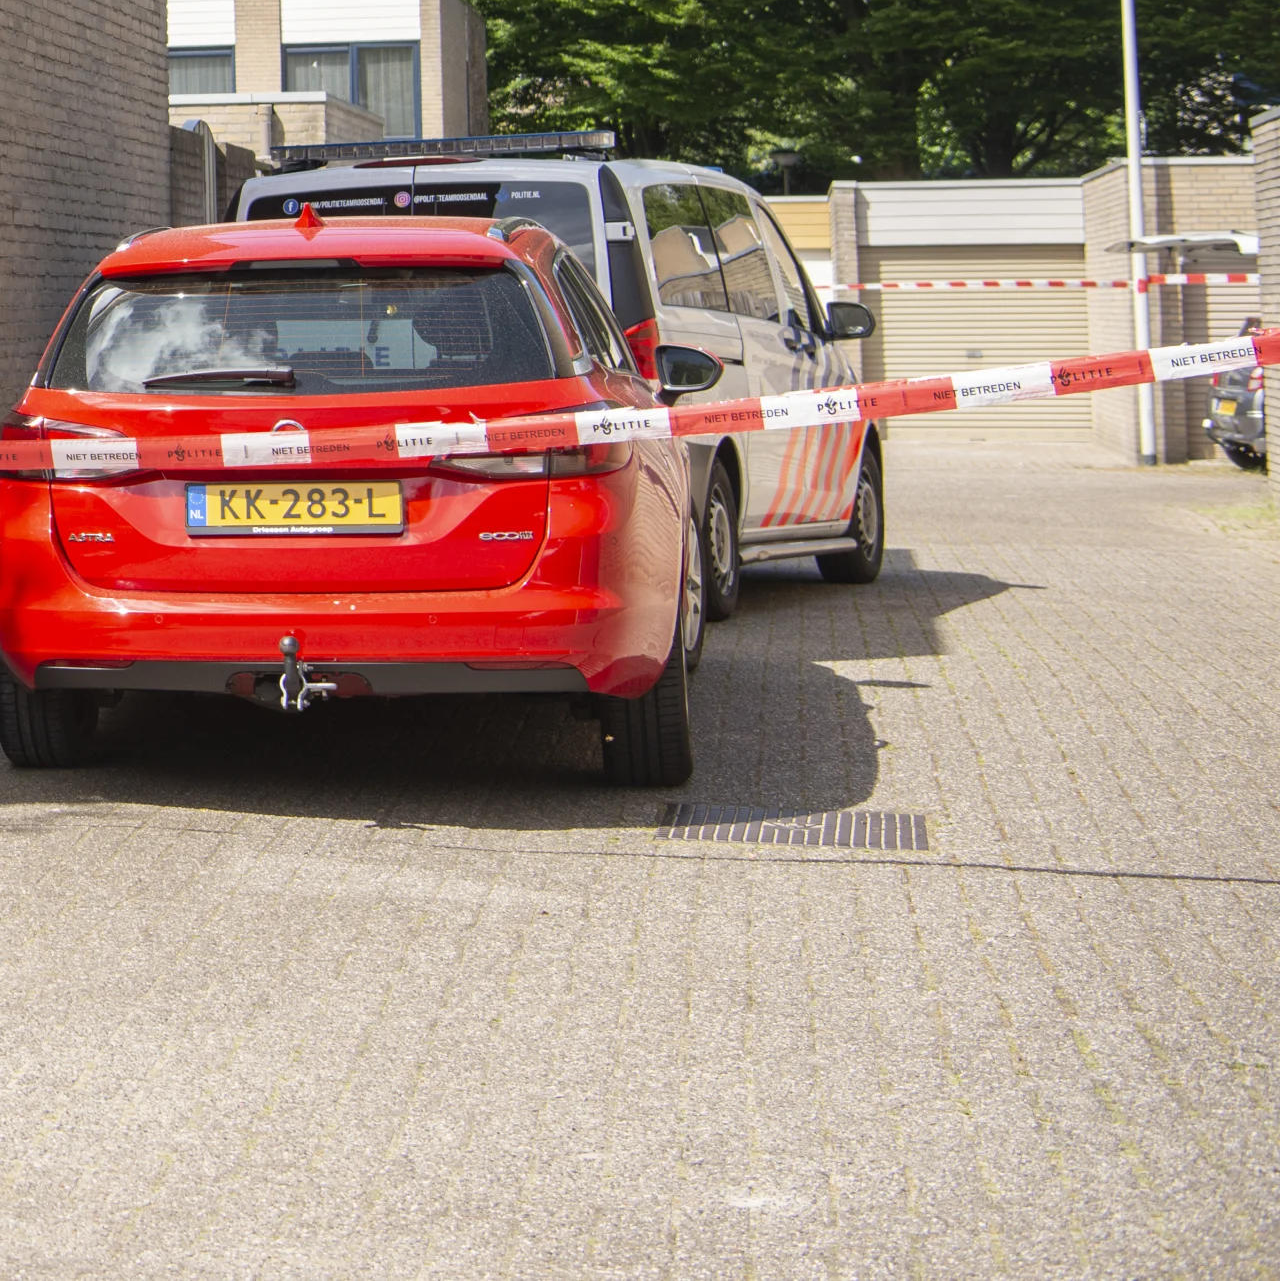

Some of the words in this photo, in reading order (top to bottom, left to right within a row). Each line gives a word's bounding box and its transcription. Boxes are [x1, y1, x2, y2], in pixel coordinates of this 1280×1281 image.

[1171, 356, 1196, 367] NIET
[1200, 346, 1263, 363] BETREDEN
[933, 389, 958, 400] NIET
[961, 382, 1021, 397] BETREDEN
[705, 414, 727, 423] NIET
[731, 408, 789, 421] BETREDEN
[484, 432, 506, 442] NIET
[510, 428, 565, 440] BETREDEN
[66, 453, 87, 461] NIET
[90, 452, 142, 461] BETREDEN
[271, 447, 293, 456] NIET
[296, 444, 350, 455] BETREDEN
[190, 510, 204, 519] NL
[218, 487, 386, 520] KK-283-L
[68, 532, 115, 542] ASTRA
